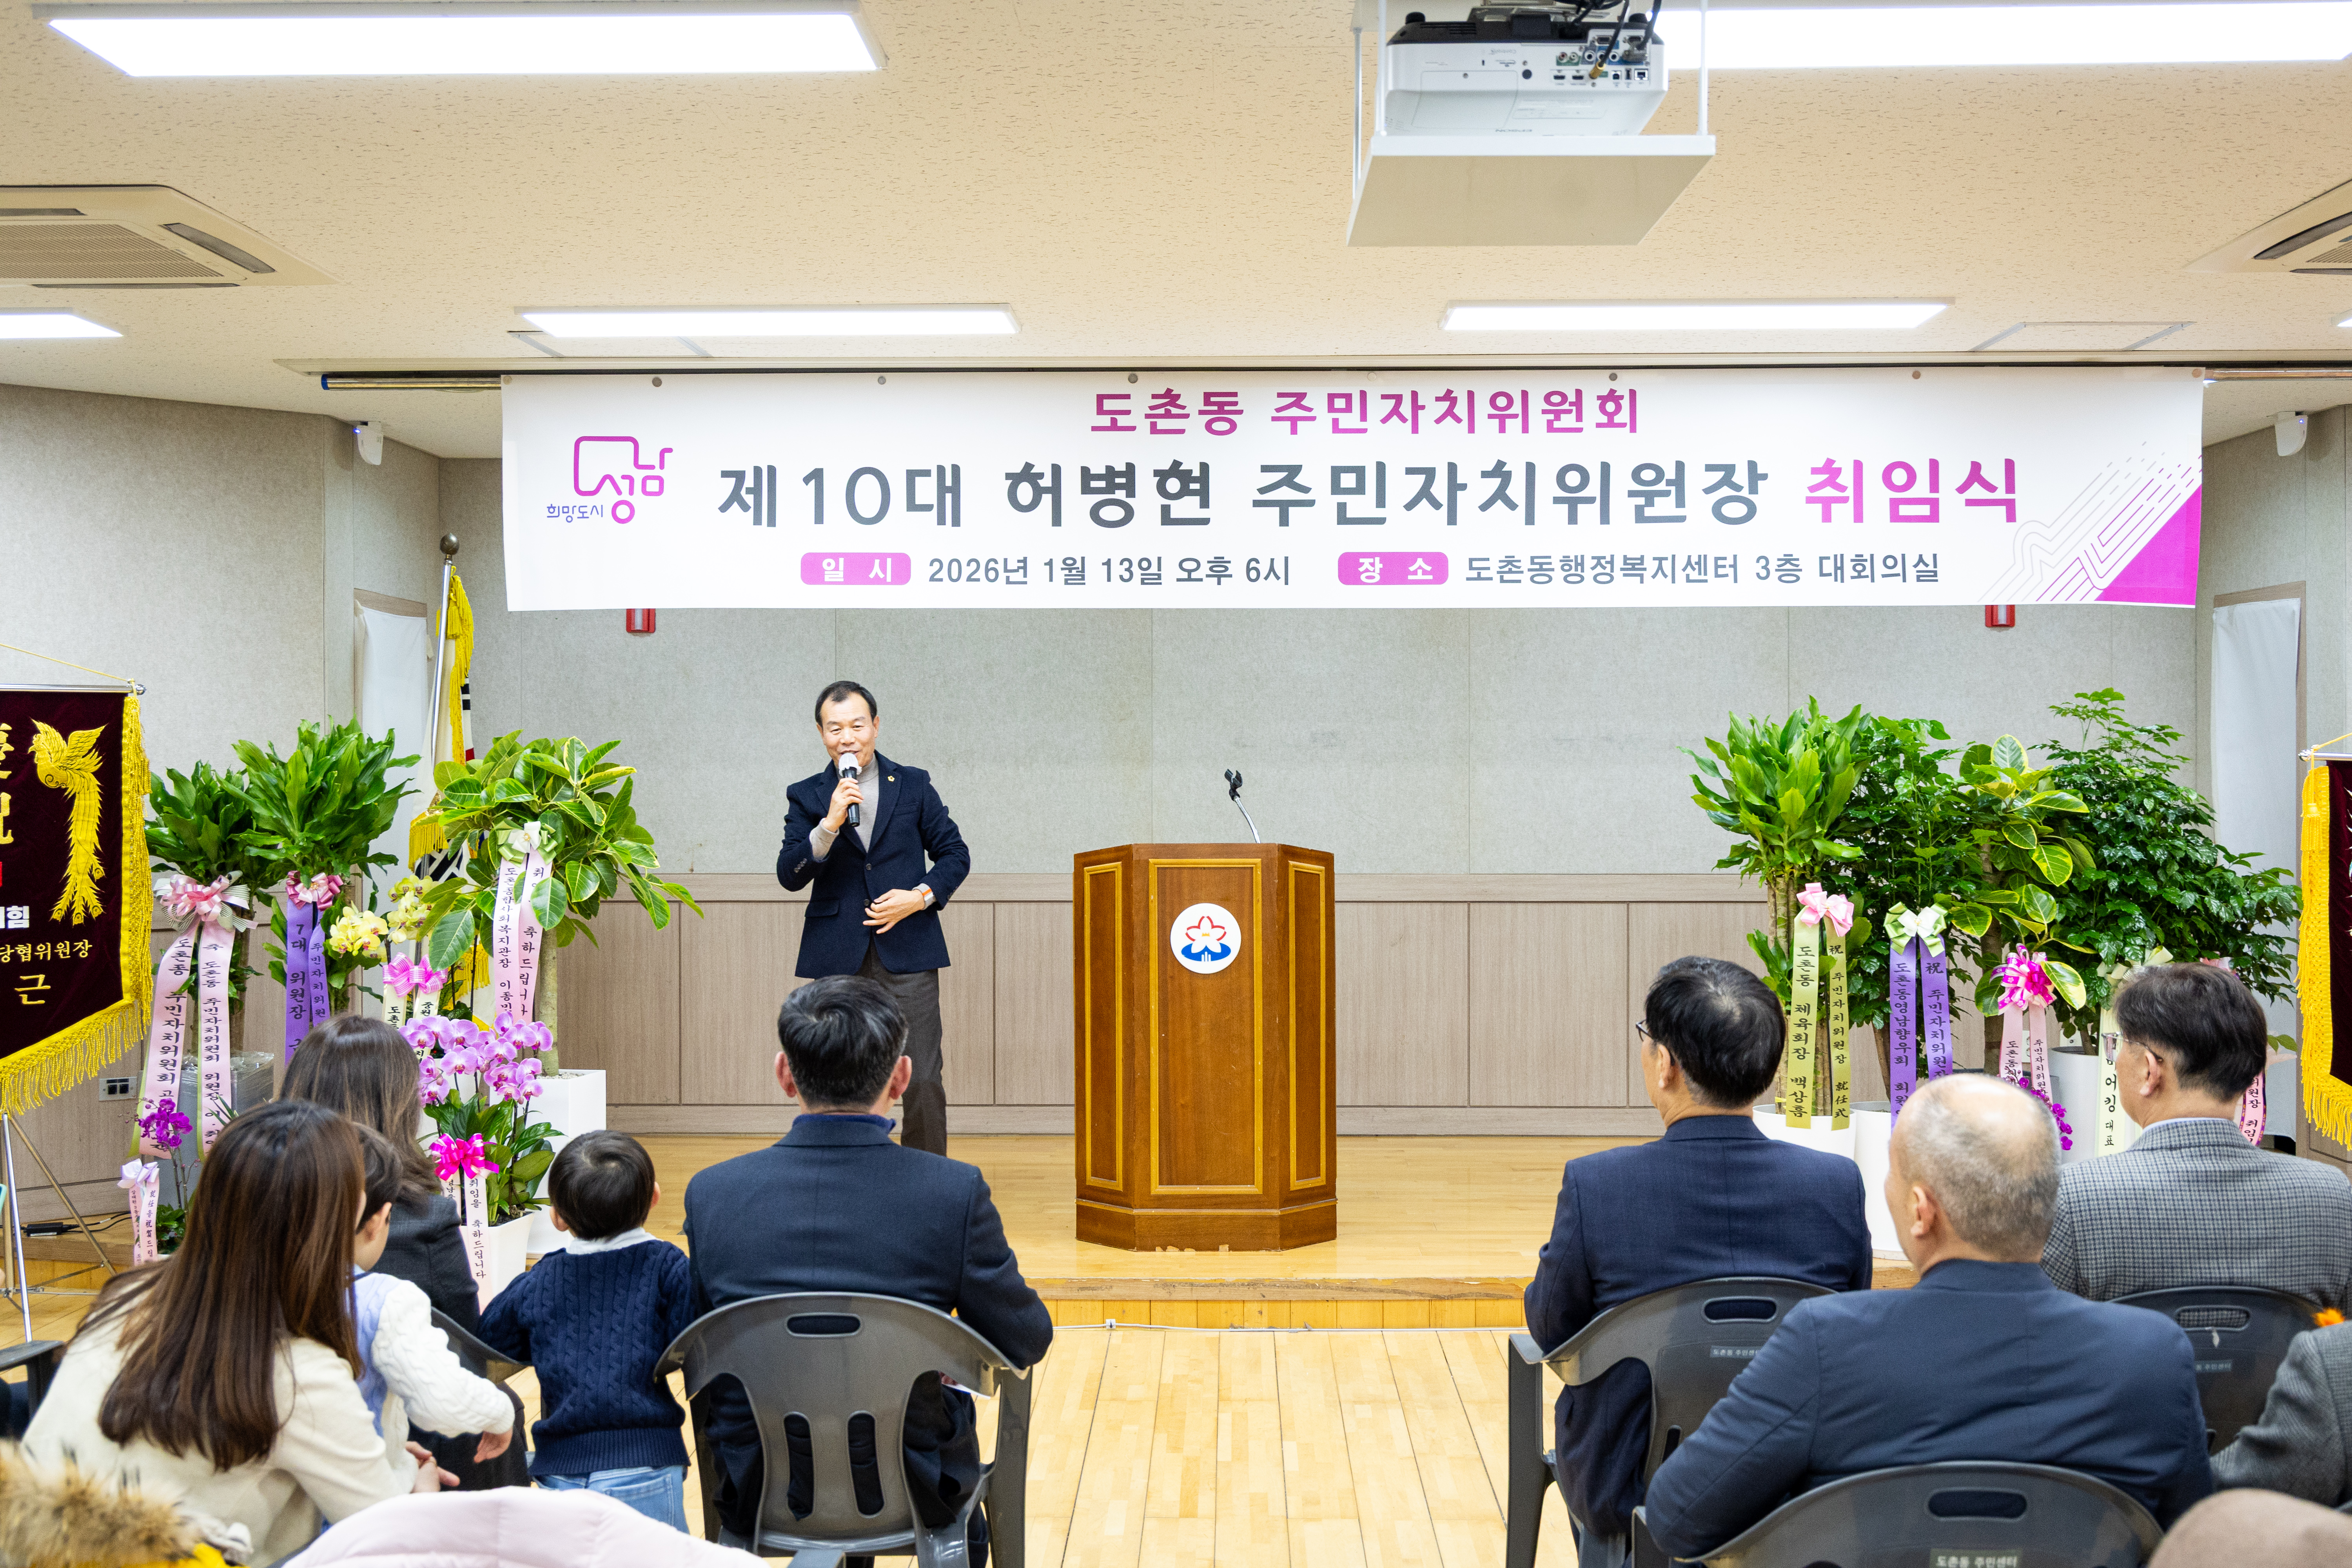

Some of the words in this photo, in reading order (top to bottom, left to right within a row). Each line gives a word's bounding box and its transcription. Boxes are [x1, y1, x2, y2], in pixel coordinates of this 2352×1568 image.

[1091, 387, 1244, 436] 도촌동
[1270, 387, 1637, 436] 주민자치위원회
[717, 464, 961, 528] 제10대
[1005, 459, 1211, 528] 허병현
[1252, 459, 1769, 527] 주민자치위원장
[1805, 457, 2017, 524] 취임식
[546, 503, 604, 524] 희망도시
[929, 556, 1028, 585] 2026년
[1044, 556, 1086, 585] 1월
[1102, 556, 1163, 586] 13일
[1176, 556, 1233, 586] 오후
[1245, 556, 1289, 586] 6시
[1465, 554, 1738, 585] 도촌동행정복지센터
[1755, 554, 1803, 584] 3층
[1818, 553, 1939, 583] 대회의실
[0, 906, 29, 929] 힘
[168, 938, 192, 975] 도촌동
[290, 924, 307, 952] 7대
[1829, 945, 1844, 955] 祝
[201, 961, 221, 987] 도촌동
[1796, 946, 1815, 987] 도촌동
[1925, 962, 1944, 975] 祝
[14, 974, 51, 1005] 근
[289, 971, 307, 1020] 위원장
[203, 998, 222, 1062] 주민자치위원회
[1791, 1003, 1813, 1060] 체육회장
[1831, 972, 1847, 1064] 주민자치위원장
[1893, 962, 1911, 1067] 도촌동영남향우회
[156, 991, 187, 1085] 주민자치위원회
[204, 1073, 223, 1101] 위원장
[1788, 1076, 1808, 1118] 백상흠
[1834, 1081, 1849, 1118] 就任式
[2244, 1119, 2258, 1142] 취임
[469, 1178, 481, 1208] 취임을
[472, 1220, 486, 1279] 축하드립니다
